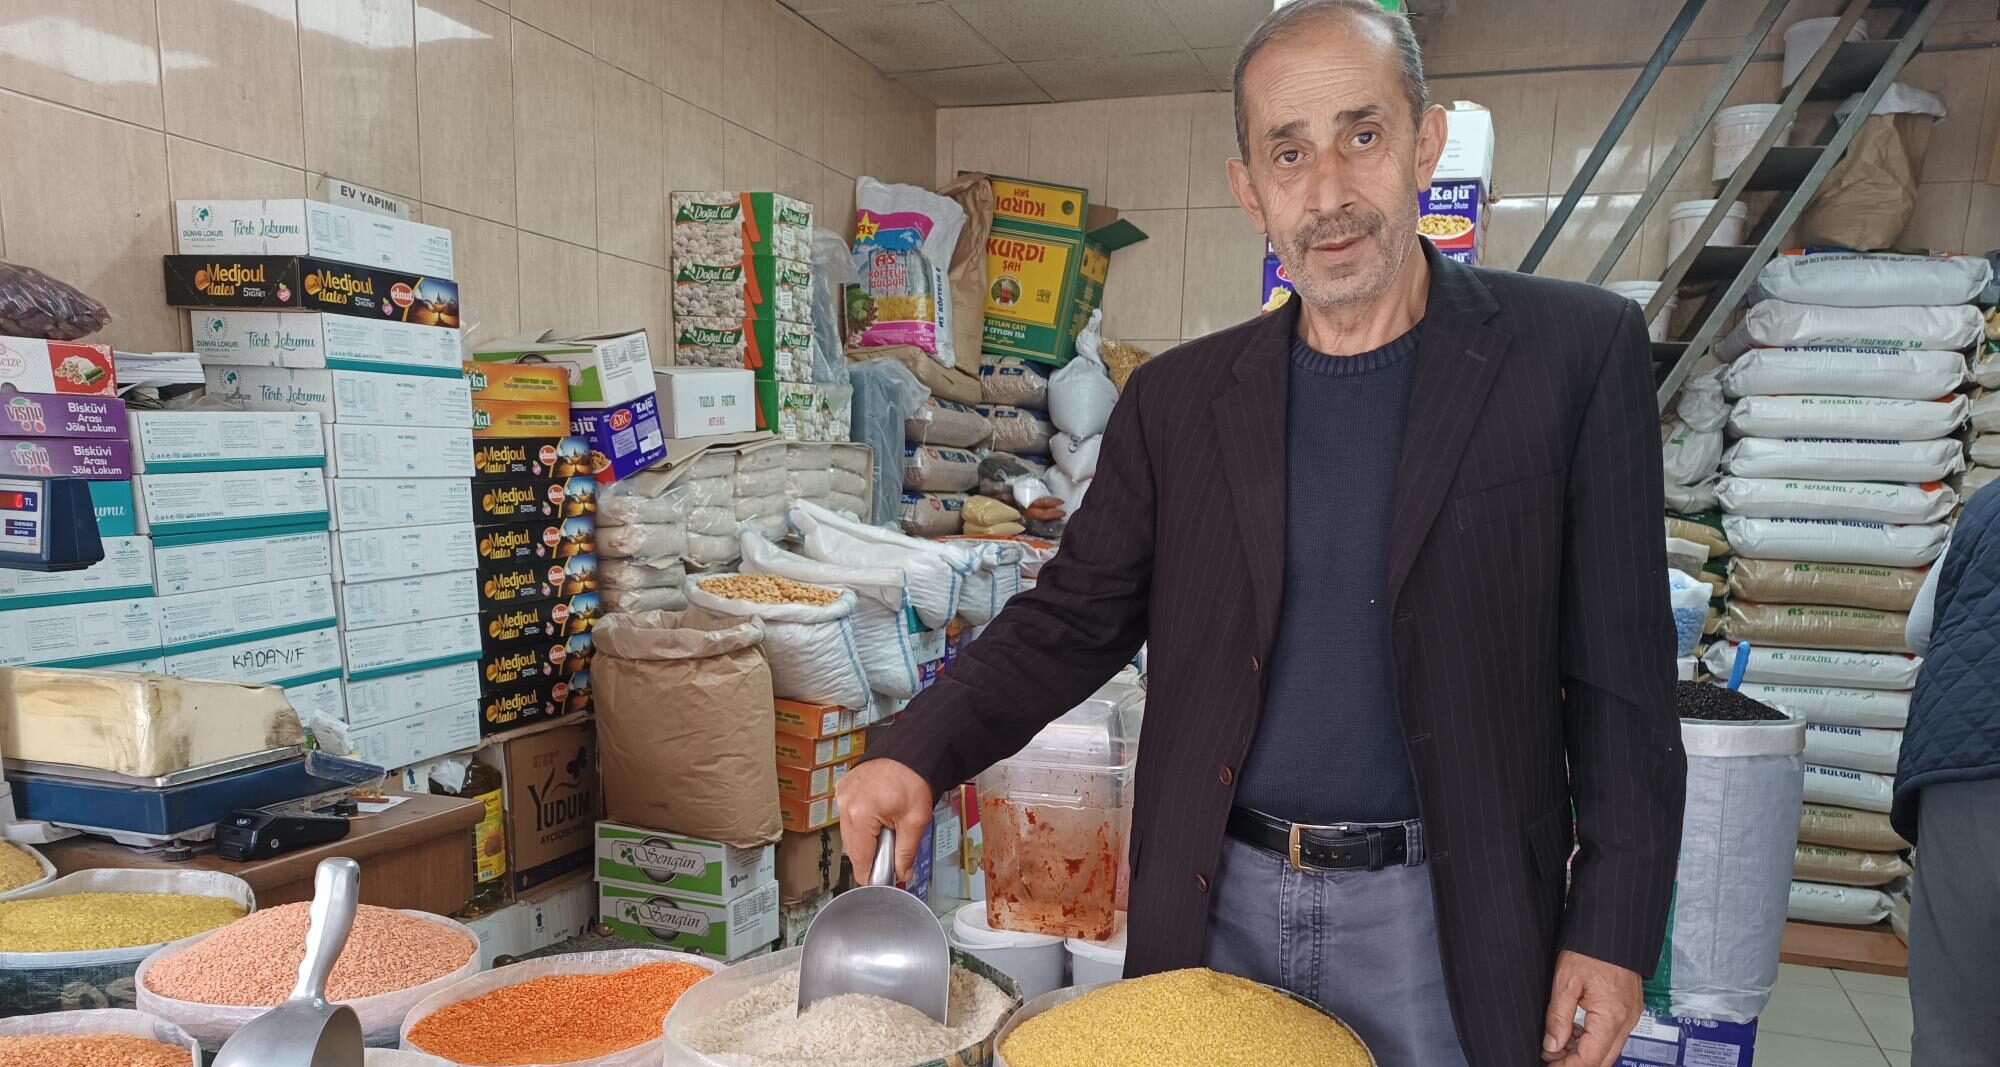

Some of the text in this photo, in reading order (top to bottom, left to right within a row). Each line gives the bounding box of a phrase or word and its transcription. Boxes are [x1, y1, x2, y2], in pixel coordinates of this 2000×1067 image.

[340, 185, 397, 214] EV YAPIMI
[1429, 187, 1470, 202] Kaju
[230, 220, 255, 236] Türk
[259, 218, 299, 239] Lokumu
[858, 224, 874, 235] AS
[875, 253, 896, 267] AS
[207, 264, 266, 286] Medjoul
[318, 269, 374, 296] Medjoul
[871, 279, 904, 289] BULGUR
[208, 284, 235, 296] dates
[318, 288, 348, 304] dates
[245, 331, 270, 347] Türk
[274, 331, 316, 351] Lokumu
[258, 385, 283, 401] Türk
[286, 385, 326, 405] Lokumu
[68, 402, 107, 414] Bisküvi
[635, 400, 654, 413] Kaju
[77, 415, 102, 423] Arası
[613, 411, 631, 427] ARC
[65, 423, 117, 433] Jöle Lokum
[73, 446, 112, 456] Bisküvi
[484, 446, 526, 464] Medjoul
[84, 457, 107, 465] Arası
[72, 465, 122, 475] Jöle Lokum
[485, 463, 506, 473] dates
[24, 497, 34, 506] TL
[492, 487, 535, 506] Medjoul
[493, 504, 514, 515] dates
[489, 529, 530, 549] Medjoul
[490, 549, 511, 559] dates
[1794, 563, 1810, 572] AS
[494, 569, 536, 589] Medjoul
[495, 589, 516, 600] dates
[498, 608, 539, 628] Medjoul
[1787, 608, 1804, 616] AS
[499, 628, 519, 640] dates
[232, 648, 306, 669] KADAYIF
[495, 650, 536, 671] Medjoul
[1771, 652, 1784, 660] AS
[496, 670, 517, 684] dates
[495, 689, 537, 711] Medjoul
[496, 711, 517, 724] dates
[1820, 725, 1862, 736] BULGUR
[1820, 767, 1862, 781] BULGUR
